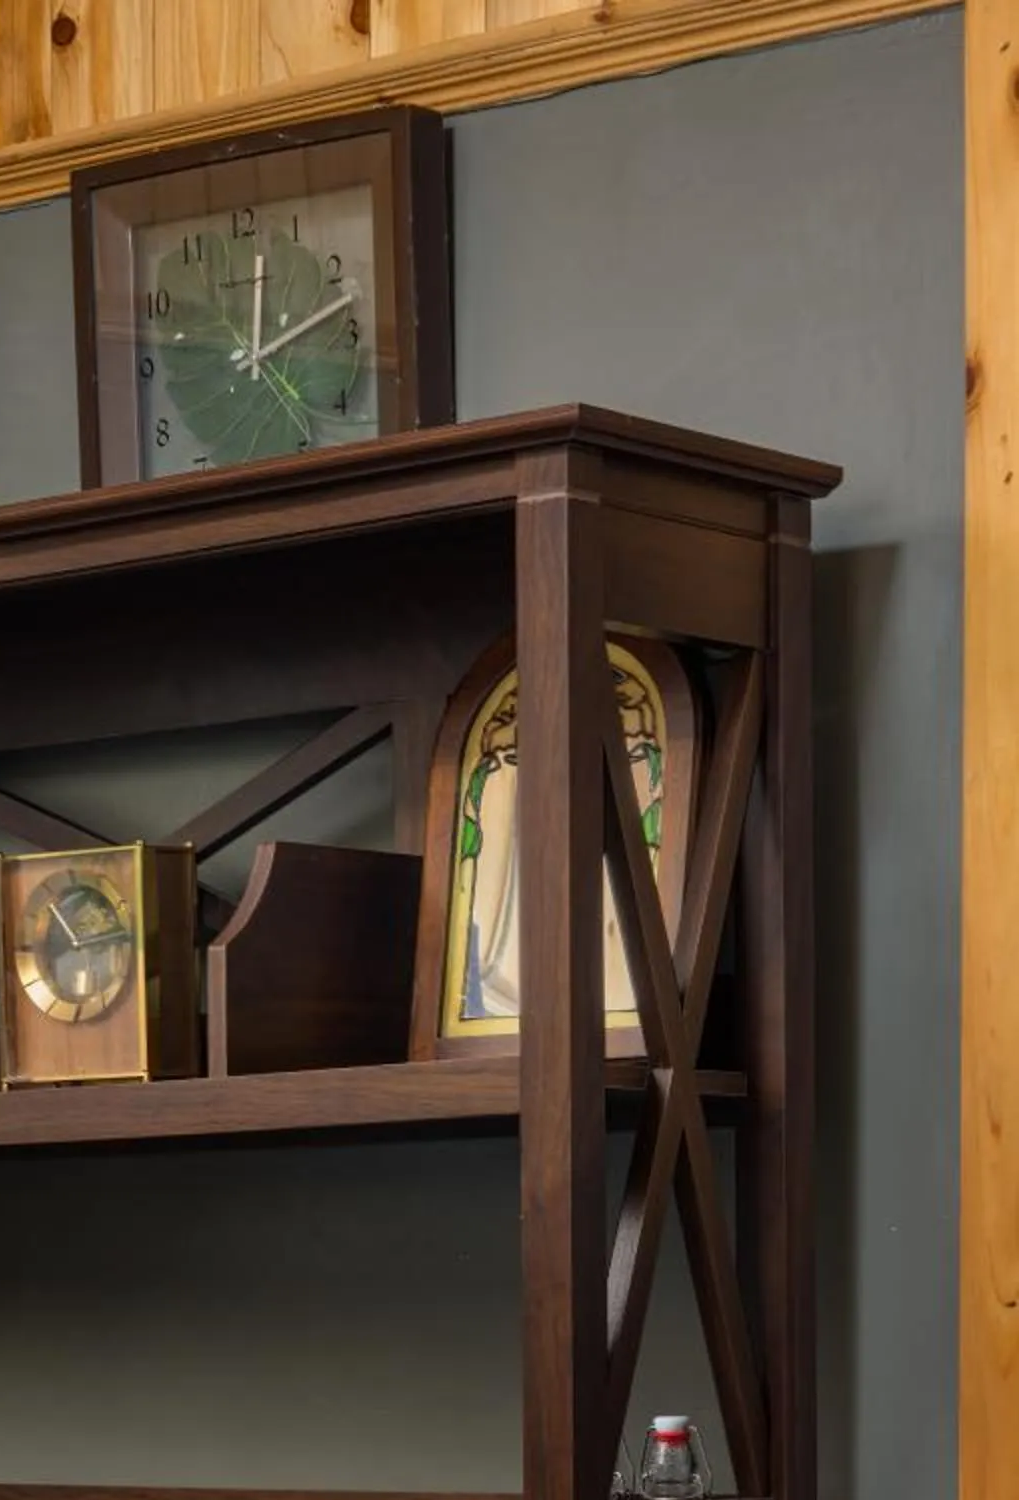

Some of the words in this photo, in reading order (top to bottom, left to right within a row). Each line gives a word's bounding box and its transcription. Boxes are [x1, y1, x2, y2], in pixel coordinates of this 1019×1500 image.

[231, 207, 256, 239] 12
[182, 233, 203, 266] 11
[326, 254, 342, 284] 2
[147, 289, 171, 320] 10
[345, 317, 358, 348] 3
[332, 388, 347, 416] 4
[156, 418, 170, 447] 8
